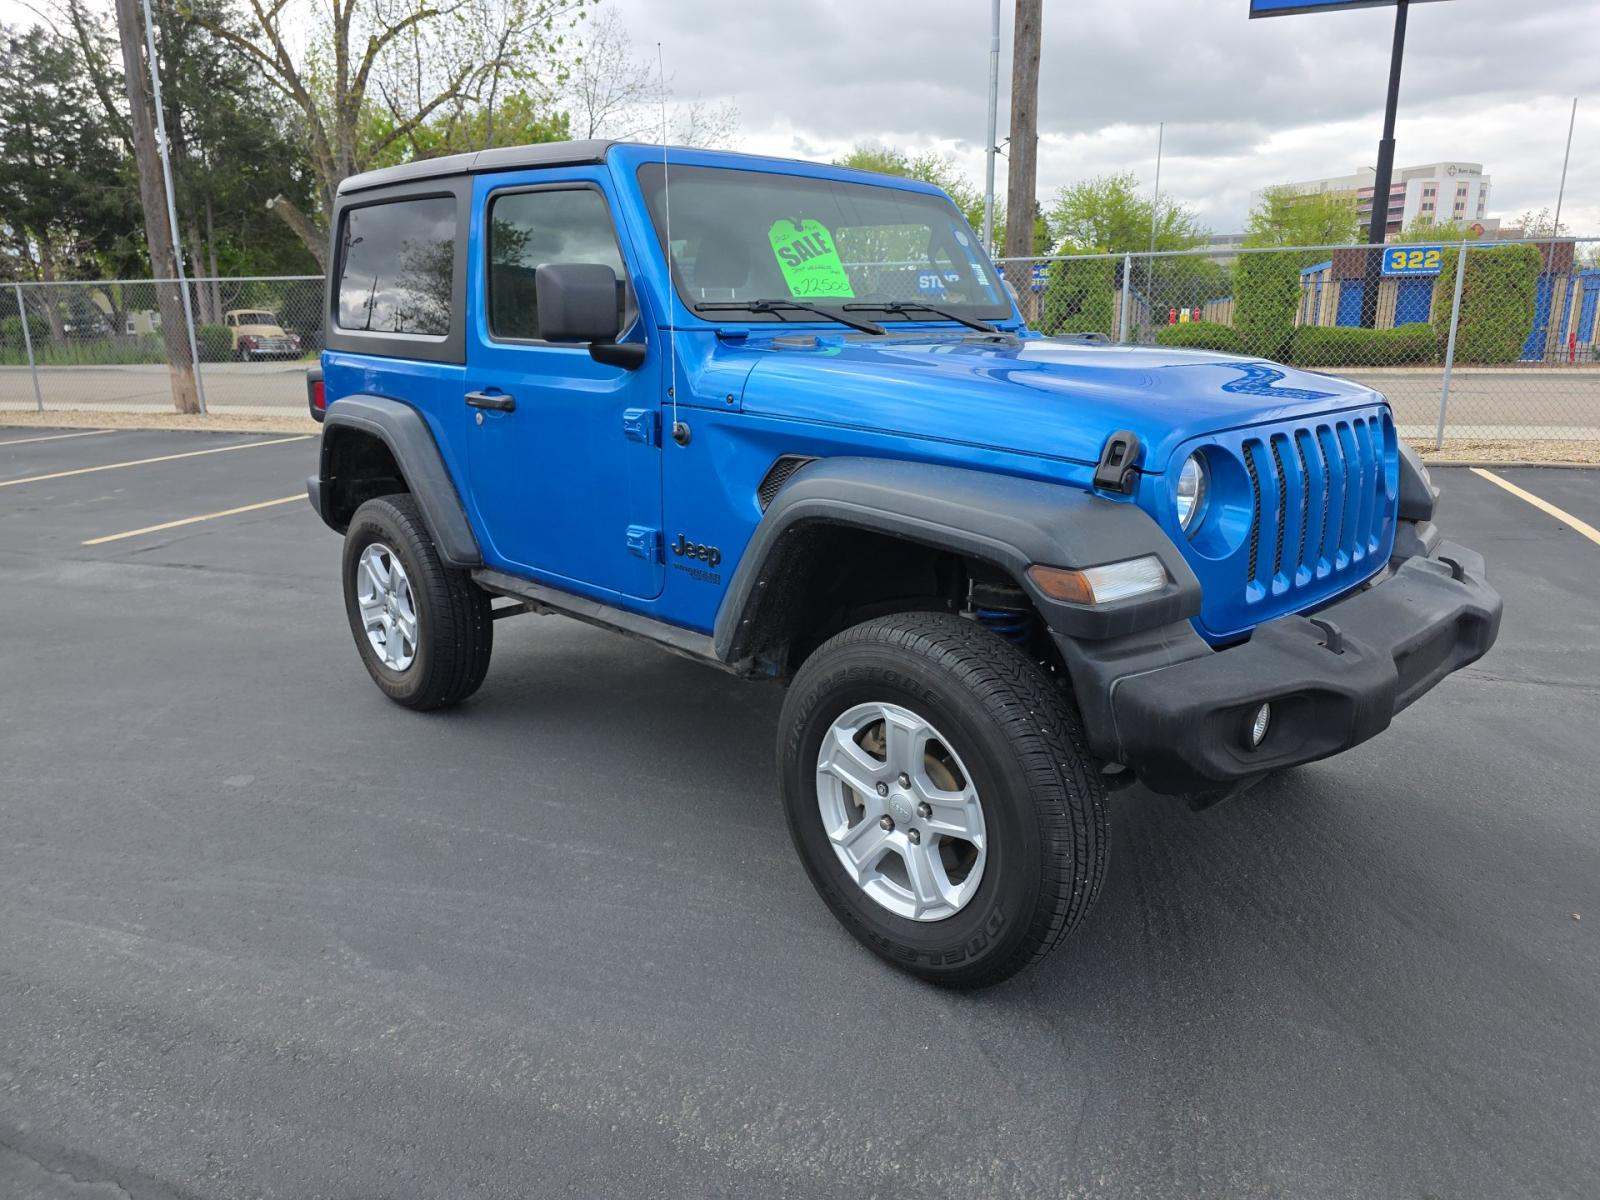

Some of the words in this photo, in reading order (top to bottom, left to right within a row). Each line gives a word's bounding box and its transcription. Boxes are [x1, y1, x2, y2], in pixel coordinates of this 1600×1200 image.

[778, 231, 832, 267] SALE
[1391, 250, 1440, 270] 322
[671, 533, 721, 568] Jeep
[784, 665, 944, 760] IDGESTONE
